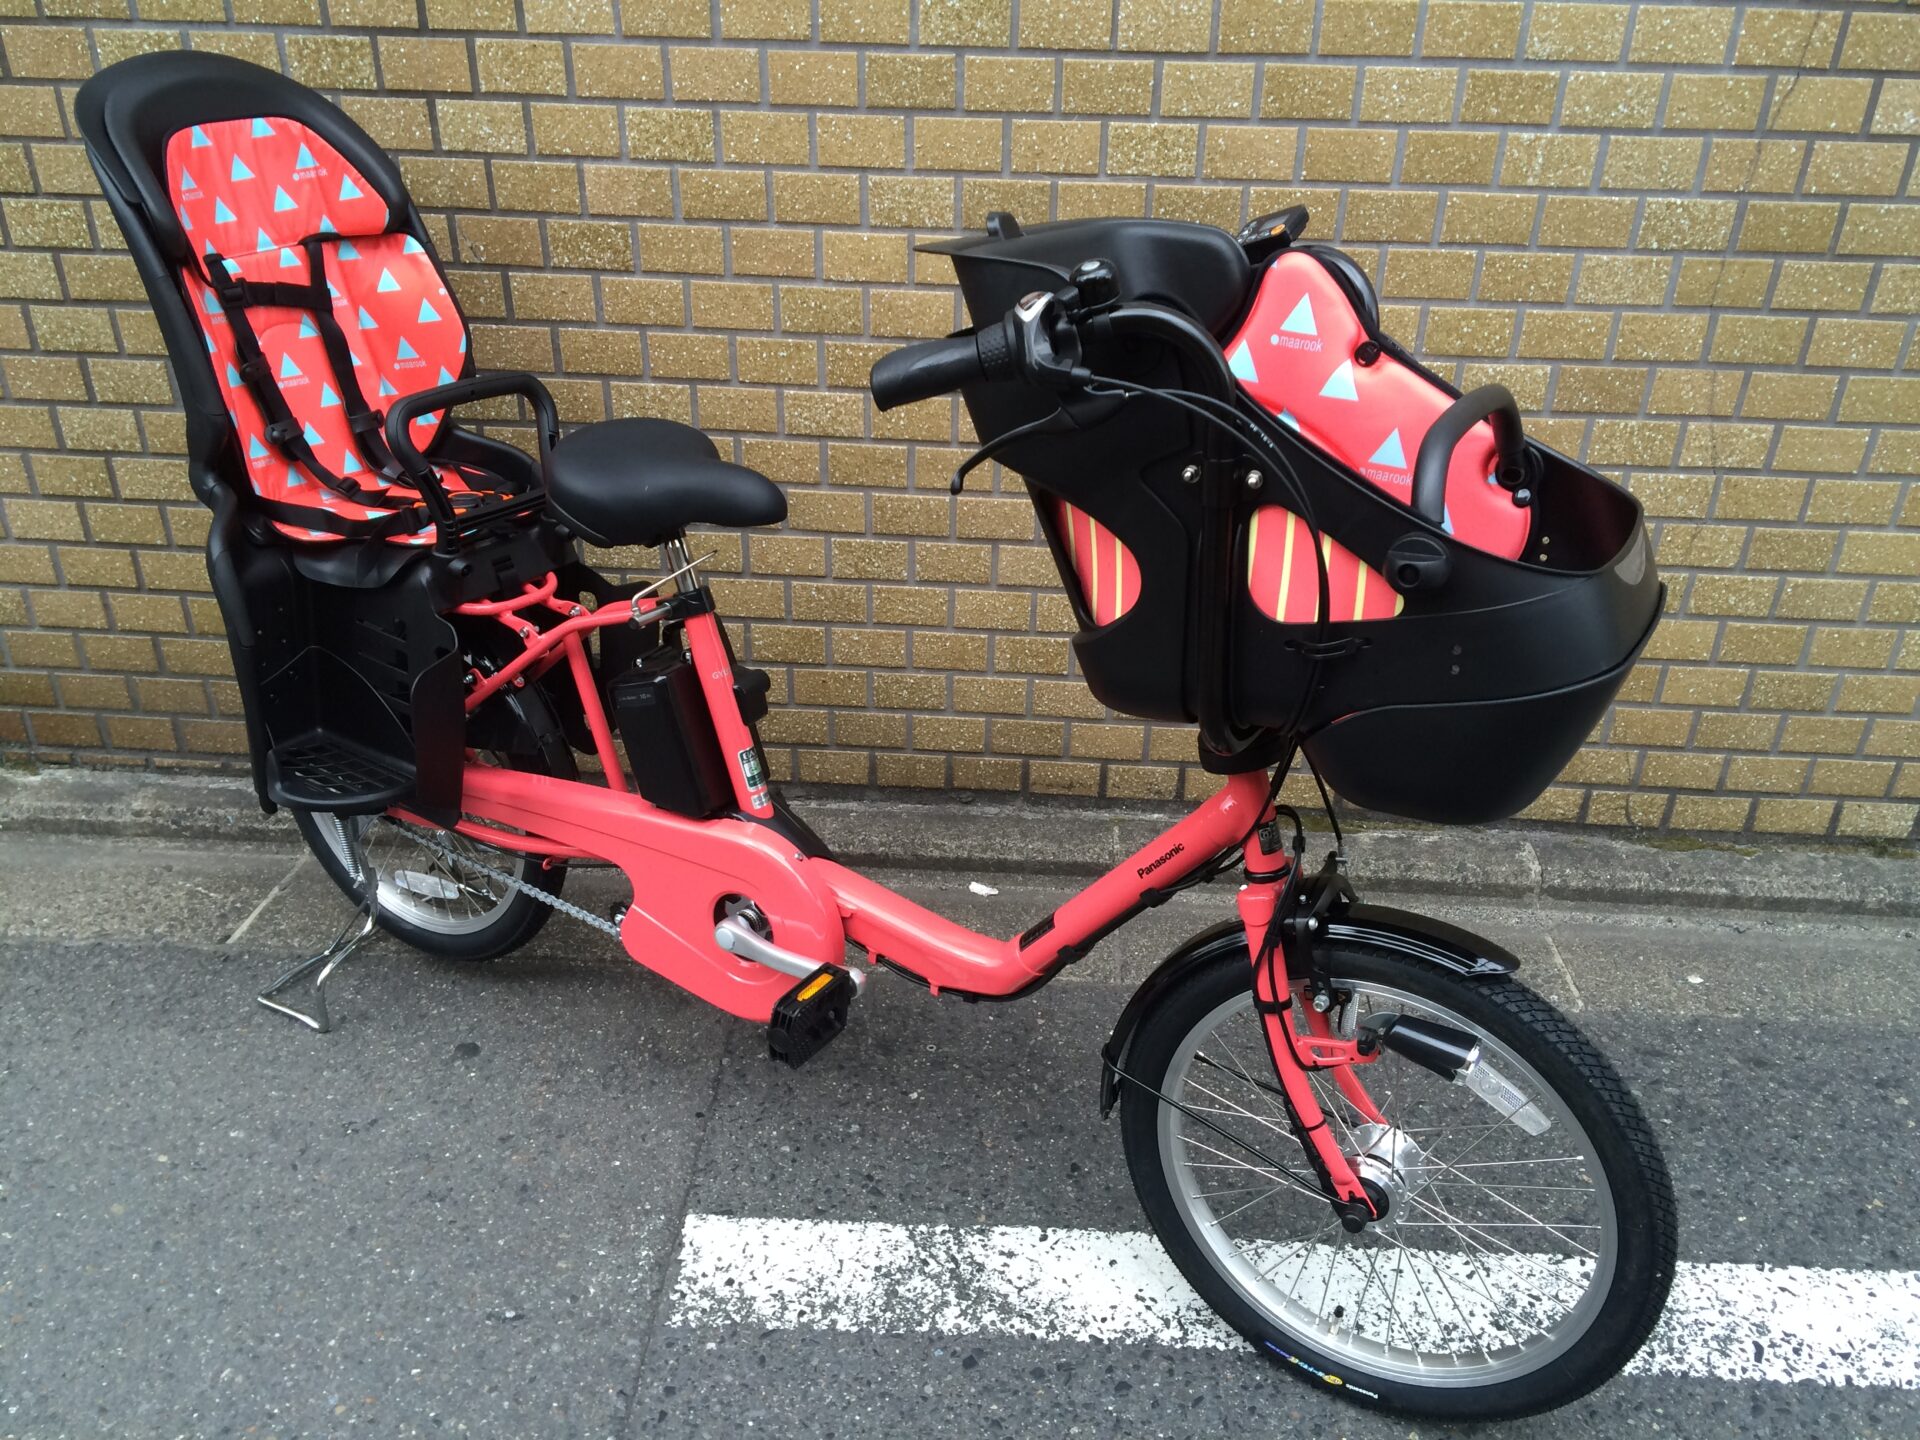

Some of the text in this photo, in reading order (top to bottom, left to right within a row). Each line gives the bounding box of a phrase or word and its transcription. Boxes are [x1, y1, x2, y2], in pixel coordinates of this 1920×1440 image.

[1279, 335, 1323, 352] maarook
[1366, 468, 1413, 487] maarook
[1137, 842, 1185, 879] Panasonic
